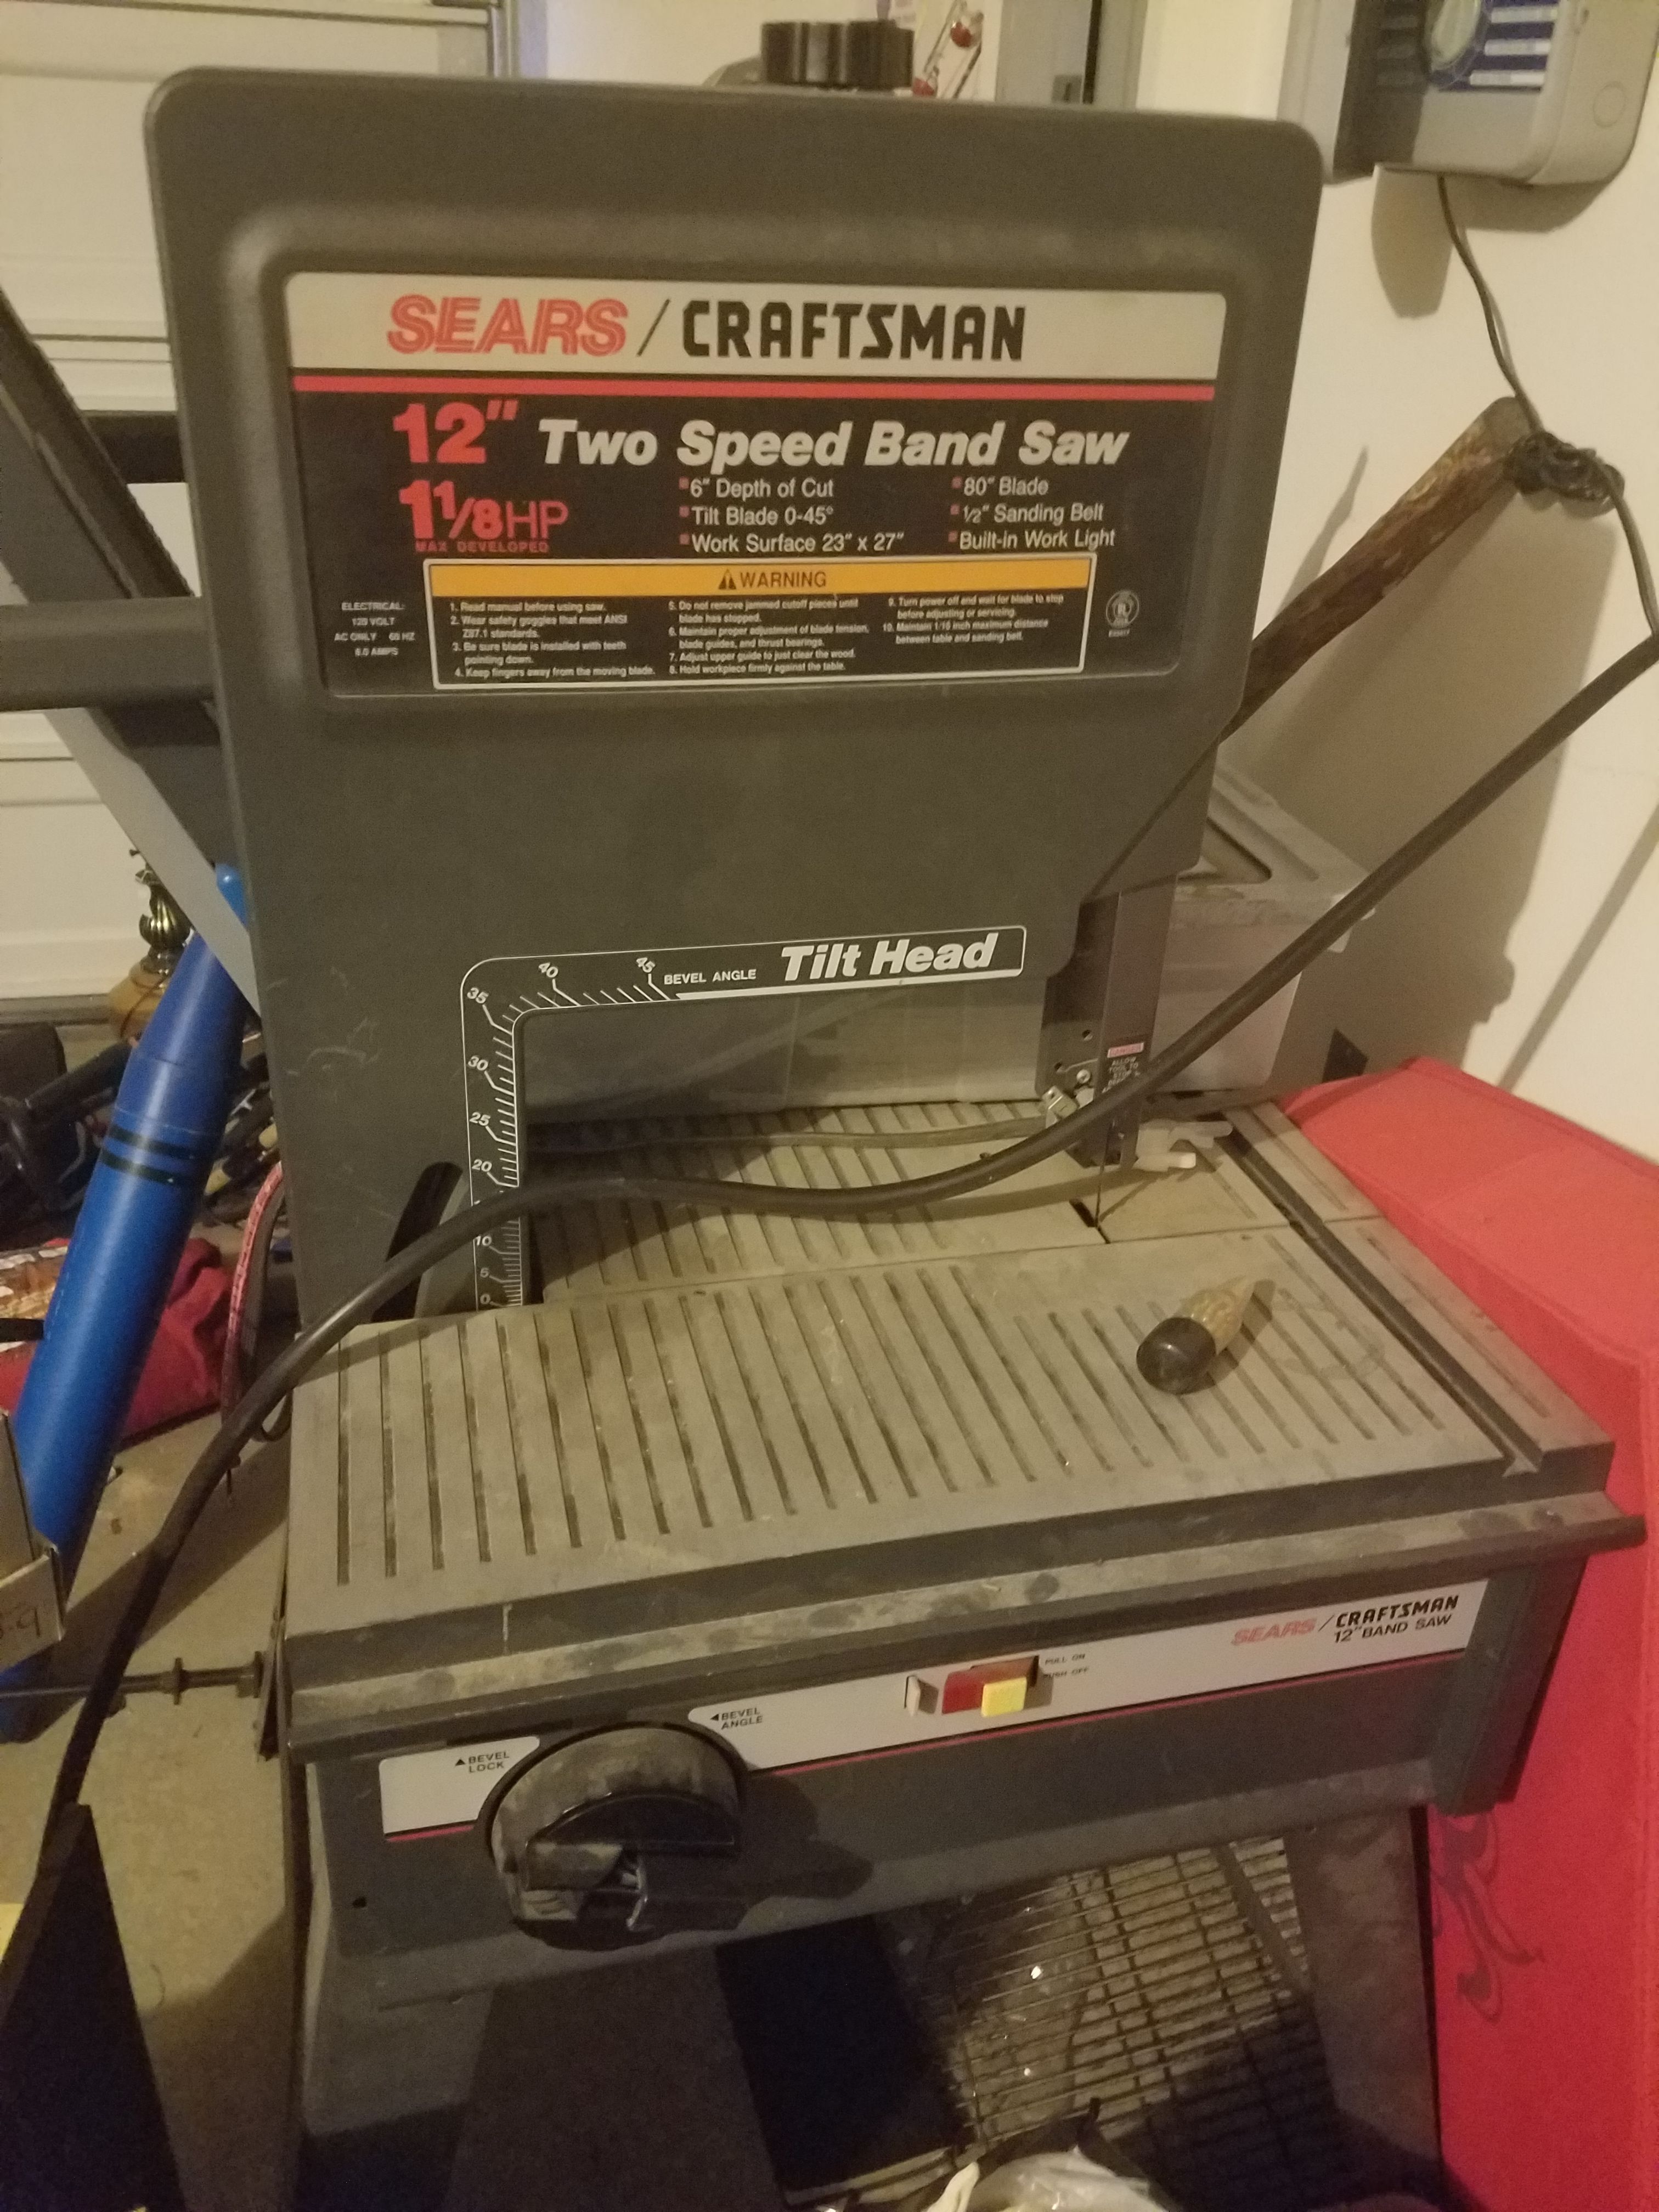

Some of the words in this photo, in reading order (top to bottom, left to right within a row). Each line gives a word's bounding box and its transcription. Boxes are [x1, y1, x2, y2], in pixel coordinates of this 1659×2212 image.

[387, 294, 628, 357] SEARS
[682, 300, 1025, 360] CRAFTSMAN
[393, 400, 518, 464] 12"
[538, 418, 658, 465] Two
[676, 420, 853, 475] Speed
[863, 420, 1006, 466] Band
[1019, 420, 1130, 465] Saw
[716, 478, 771, 501] Depth
[777, 478, 795, 498] of
[801, 478, 833, 498] Cut
[963, 476, 995, 496] 80"
[999, 476, 1048, 495] Blade
[691, 506, 719, 525] Tilt
[726, 506, 778, 526] Blade
[994, 503, 1064, 526] Sanding
[1070, 502, 1103, 522] Belt
[457, 540, 549, 552] DEVELOPED
[692, 533, 739, 552] Work
[746, 533, 816, 552] Surface
[822, 533, 853, 552] 23"
[857, 537, 868, 551] x
[873, 531, 904, 551] 27"
[1025, 530, 1068, 548] Work
[1075, 528, 1115, 552] Light
[740, 571, 827, 588] WARNING
[636, 956, 656, 973] 45
[781, 943, 861, 981] Tilt
[869, 932, 999, 975] Head
[538, 962, 559, 978] 40
[664, 972, 707, 985] BEVEL
[713, 968, 757, 981] ANGLE
[466, 987, 488, 1005] 35
[467, 1055, 488, 1071] 30
[469, 1112, 490, 1126] 25
[472, 1159, 492, 1172] 20
[475, 1235, 492, 1246] 10
[480, 1268, 489, 1278] 5
[479, 1294, 491, 1305] 0
[1231, 1618, 1317, 1645] SEARS
[1335, 1595, 1459, 1628] CRAFTSMAN
[1362, 1621, 1408, 1639] BAND
[1415, 1614, 1452, 1630] SAW
[721, 1707, 760, 1720] BEVEL
[721, 1716, 763, 1729] ANGLE
[469, 1750, 509, 1764] BEVEL
[469, 1762, 504, 1773] LOCK
